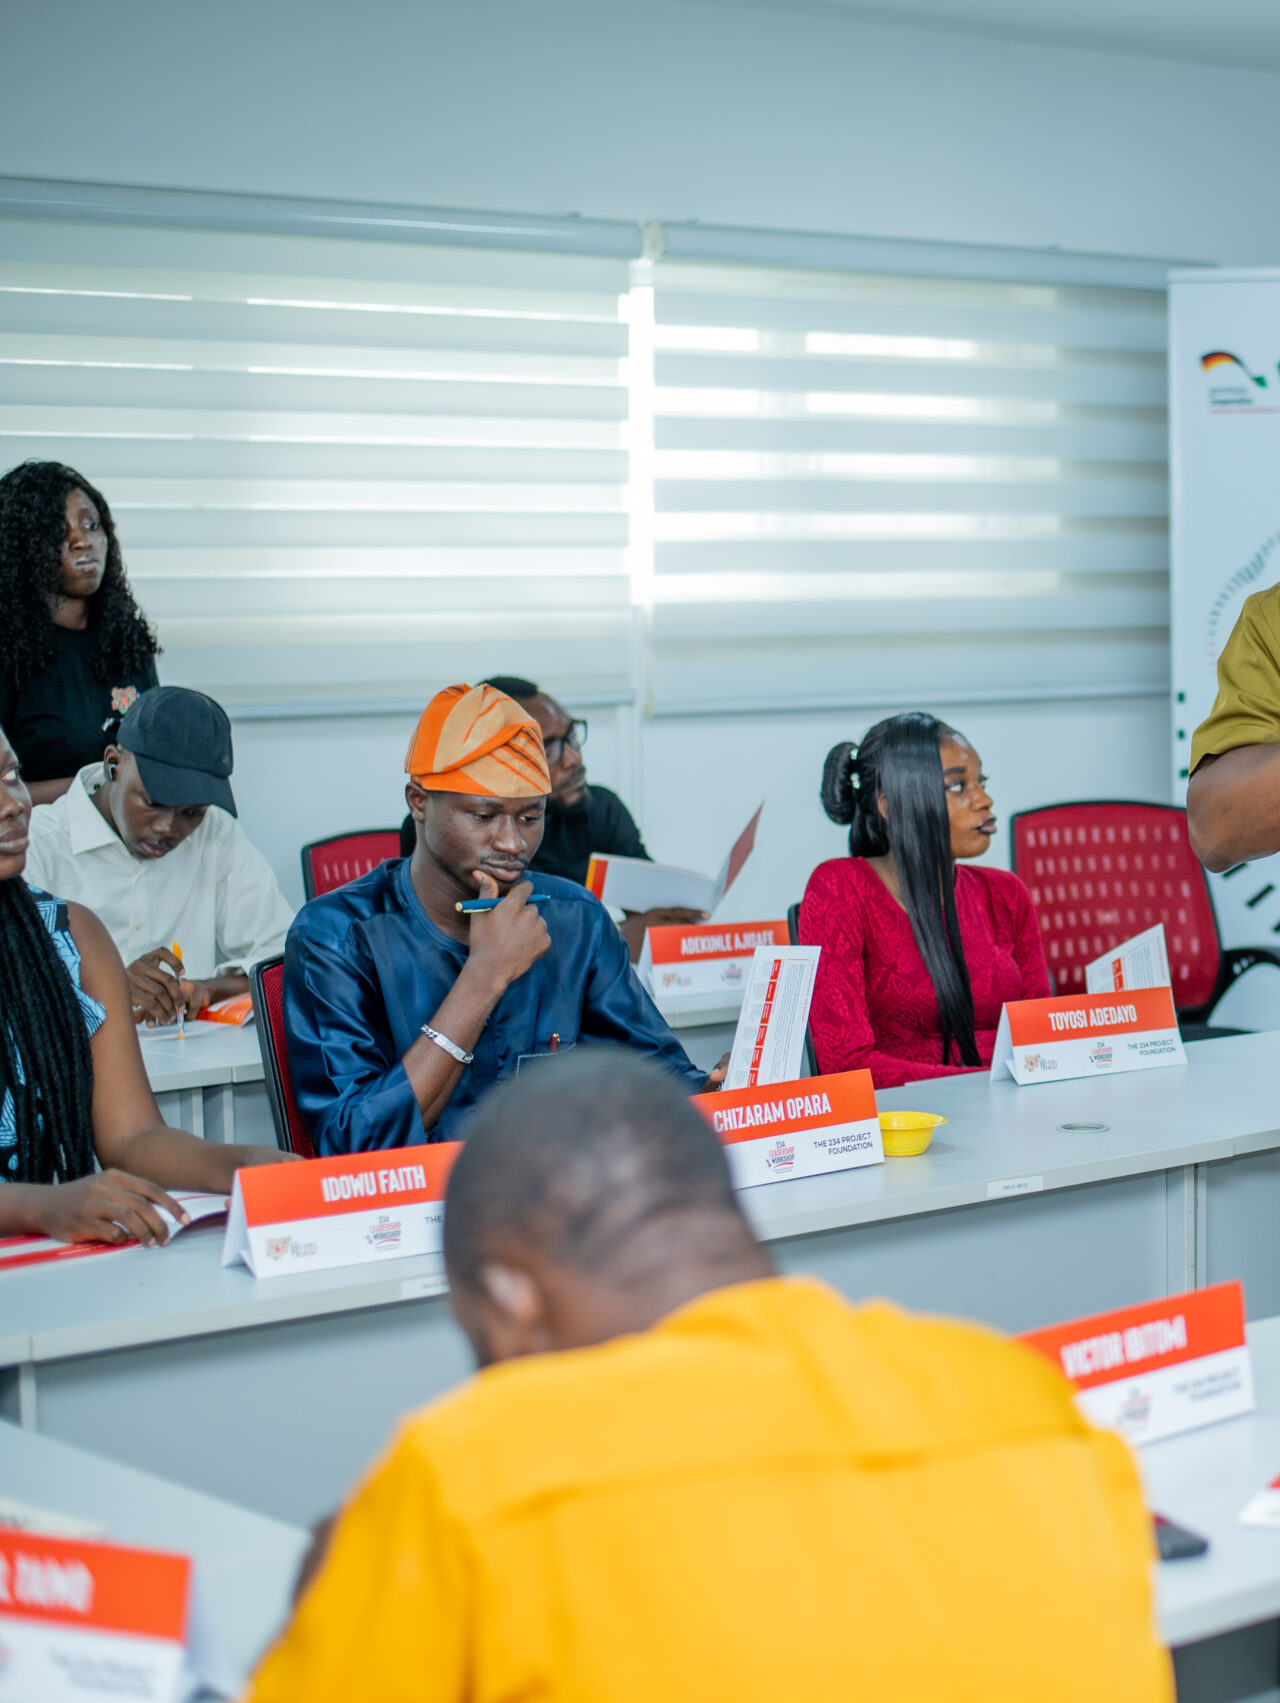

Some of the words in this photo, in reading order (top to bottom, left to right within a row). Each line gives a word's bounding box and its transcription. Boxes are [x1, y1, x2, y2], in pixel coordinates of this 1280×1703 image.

[1048, 1010, 1088, 1031] TOYOSI
[1089, 1005, 1138, 1027] ADEDAYO
[713, 1100, 785, 1133] CHIZARAM
[787, 1092, 832, 1120] OPARA
[814, 1140, 827, 1149] THE
[828, 1138, 841, 1147] 234
[842, 1132, 872, 1144] PROJECT
[828, 1141, 873, 1155] FOUNDATION
[321, 1171, 377, 1203] IDOWU
[379, 1165, 427, 1194] FAITH
[425, 1214, 443, 1225] THE
